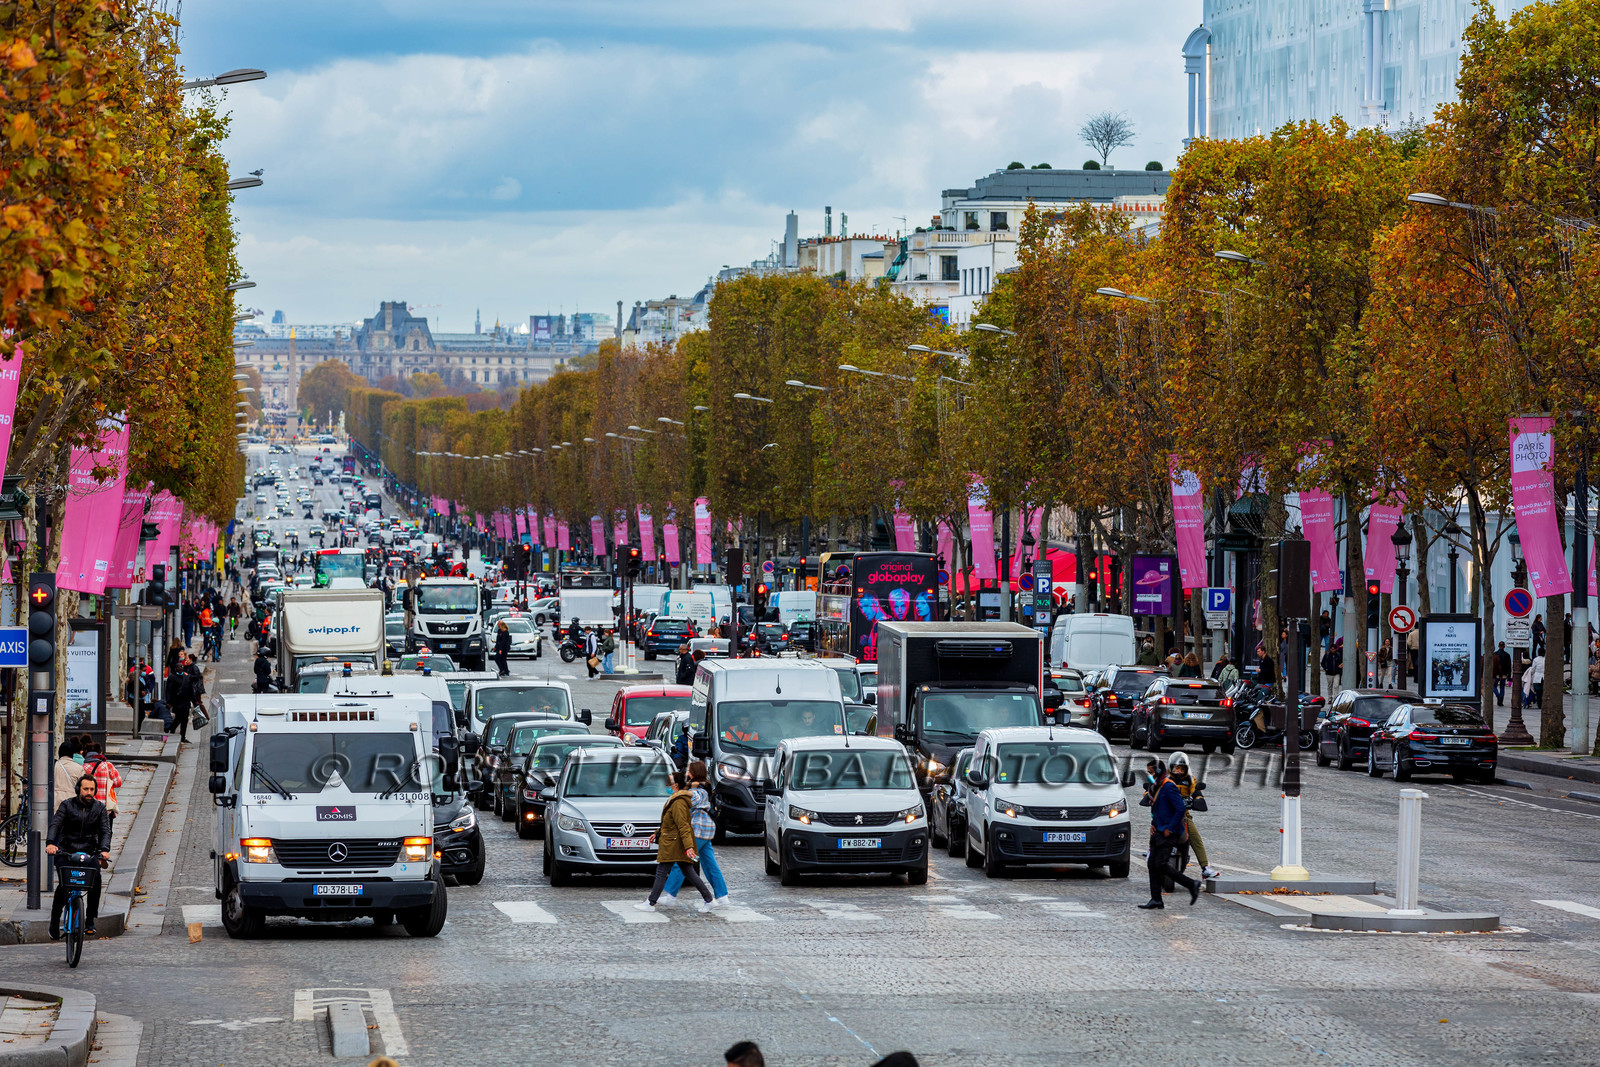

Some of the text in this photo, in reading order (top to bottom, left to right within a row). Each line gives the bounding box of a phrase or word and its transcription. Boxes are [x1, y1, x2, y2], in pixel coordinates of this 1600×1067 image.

[1518, 442, 1544, 451] PARIS
[1515, 451, 1547, 461] PHOTO
[1516, 503, 1533, 511] GRAND
[880, 562, 914, 572] original
[868, 572, 925, 585] globoplay
[1038, 578, 1050, 592] P
[1214, 592, 1224, 608] P
[308, 626, 360, 634] swipop.fr
